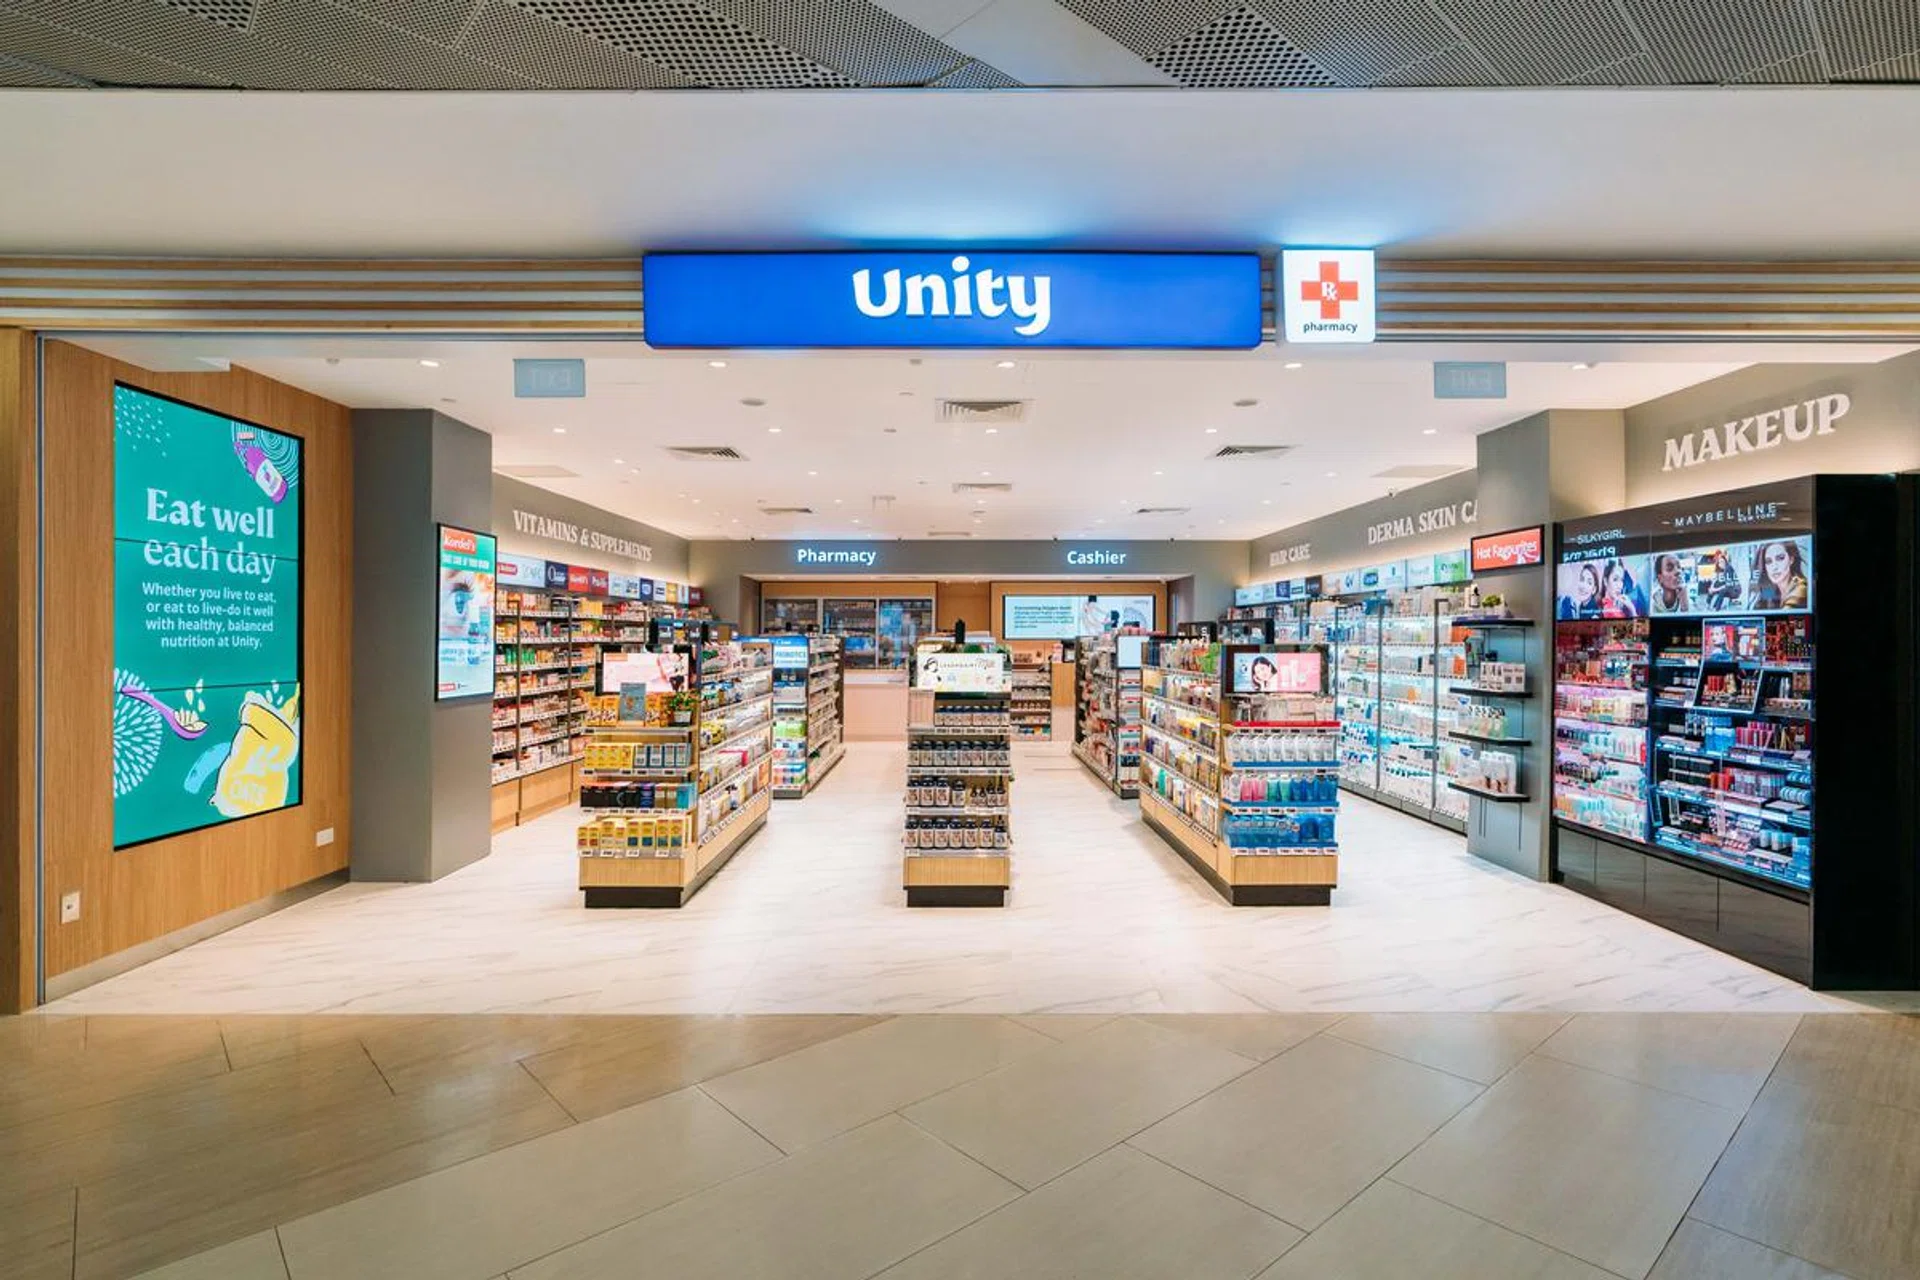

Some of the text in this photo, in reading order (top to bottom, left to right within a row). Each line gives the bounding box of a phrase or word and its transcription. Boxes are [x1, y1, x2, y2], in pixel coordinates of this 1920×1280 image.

[852, 256, 1052, 335] Unity
[1303, 321, 1358, 334] pharmacy
[1662, 393, 1850, 472] MAKEUP
[147, 487, 275, 539] Eat well
[1674, 501, 1778, 528] MAYBELLINE
[1367, 516, 1414, 545] DERMA
[1419, 503, 1457, 533] SKIN
[512, 510, 653, 562] VITAMINS & SUPPLEMENTS
[1577, 529, 1625, 545] SILKYGIRL
[143, 535, 276, 584] each day
[797, 548, 877, 566] Pharmacy
[1066, 550, 1127, 565] Cashier
[1288, 542, 1311, 562] CARE
[1476, 546, 1491, 560] Hot
[142, 582, 196, 598] Whether
[199, 588, 221, 601] you
[223, 587, 242, 600] live
[244, 590, 255, 601] to
[146, 601, 273, 617] or eat to live-do it well
[145, 617, 273, 634] with healthy, balanced
[161, 635, 262, 649] nutrition at Unity.
